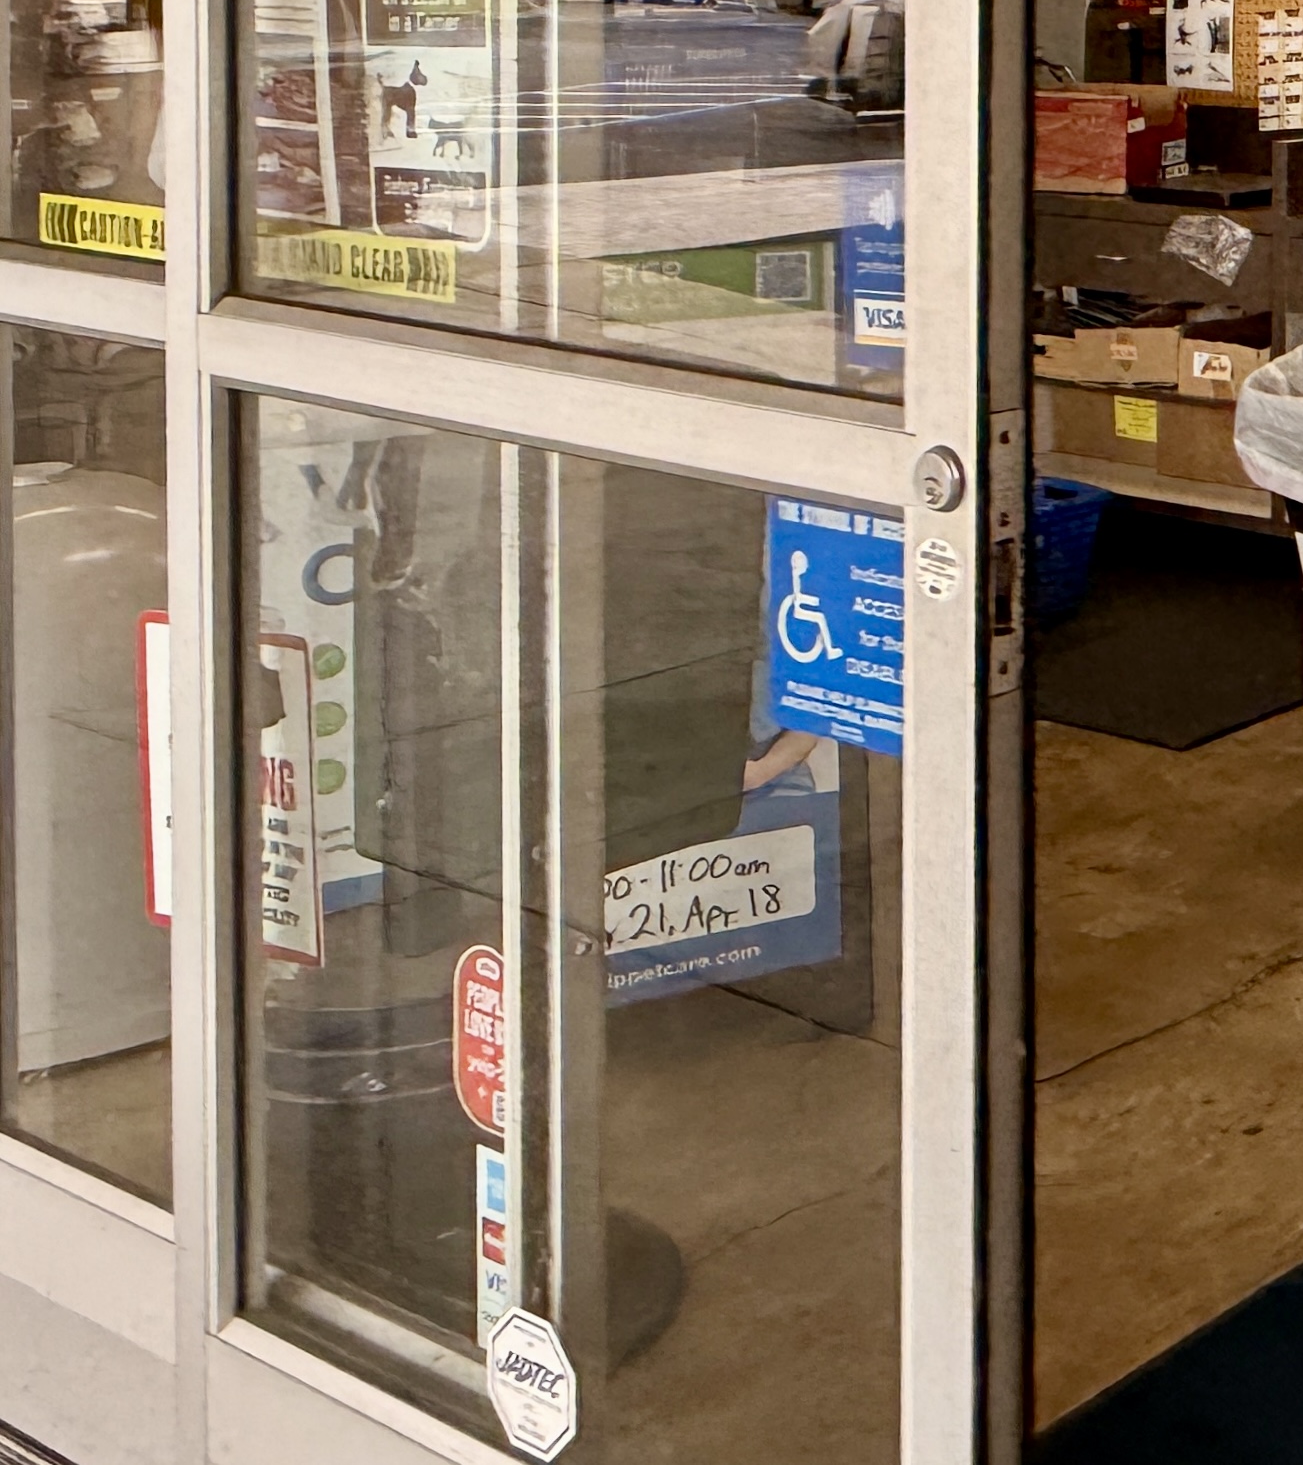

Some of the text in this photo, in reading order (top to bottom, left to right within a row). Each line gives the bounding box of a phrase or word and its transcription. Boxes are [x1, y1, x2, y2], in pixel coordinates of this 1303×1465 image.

[350, 244, 404, 284] CLEAR
[681, 895, 740, 935] Apr
[747, 883, 781, 918] 18
